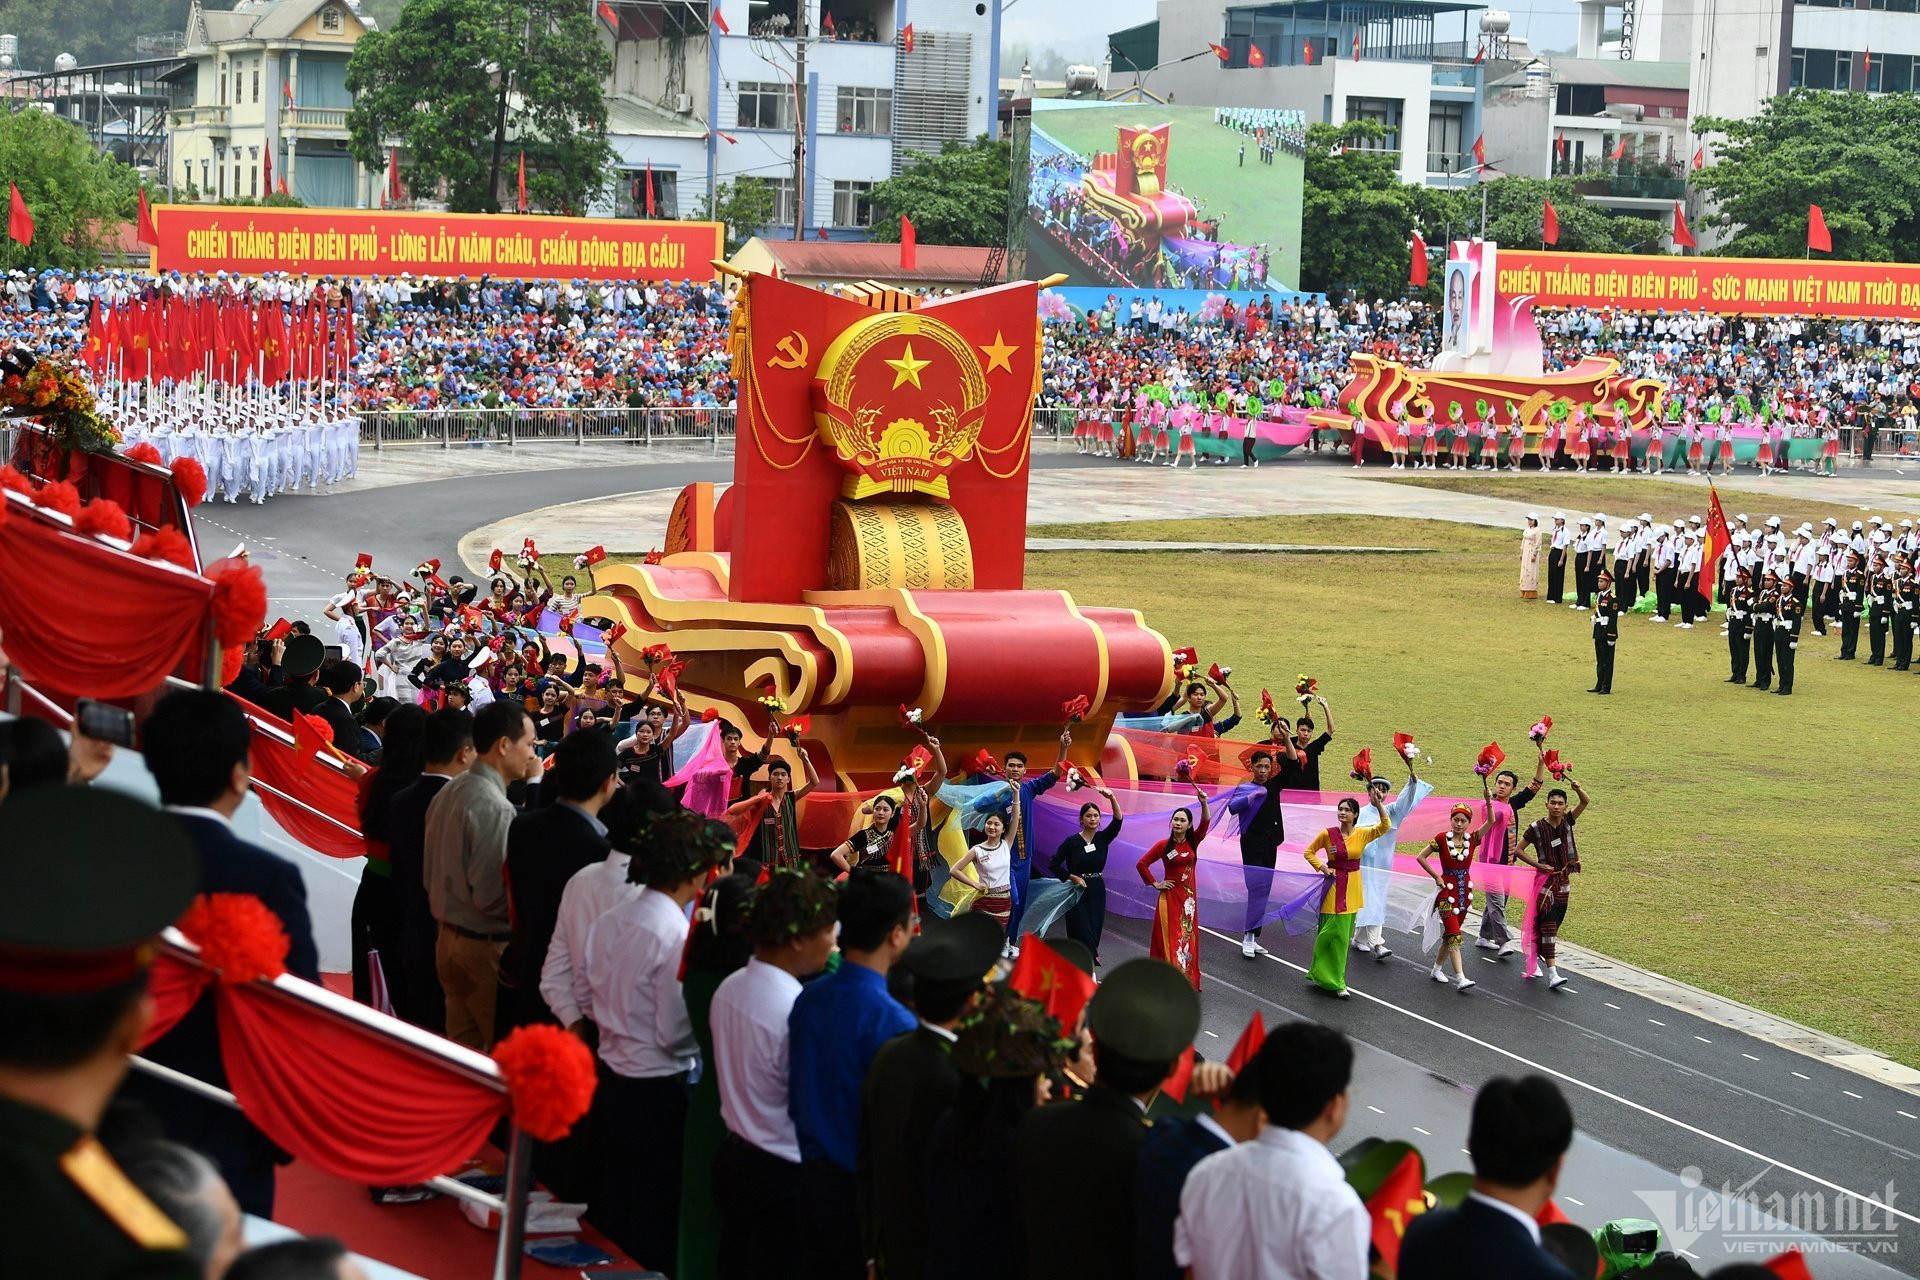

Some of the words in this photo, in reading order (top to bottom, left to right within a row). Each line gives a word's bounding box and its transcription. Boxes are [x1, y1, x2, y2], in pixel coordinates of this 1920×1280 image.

[187, 221, 227, 259] CHIẾN
[230, 220, 275, 260] THẮNG
[278, 226, 311, 266] ĐIỆN
[313, 227, 347, 261] BIÊN
[350, 225, 378, 262] PHỦ
[391, 229, 427, 263] LỪNG
[430, 225, 456, 263] LẪY
[459, 231, 492, 264] NĂM
[495, 232, 537, 268] CHÂU,
[540, 230, 578, 266] CHẤN
[581, 235, 619, 272] ĐỘNG
[622, 241, 647, 273] ĐỊA
[1499, 263, 1541, 294] CHIẾN
[1544, 263, 1591, 297] THẮNG
[1594, 269, 1628, 302] ĐIỆN
[1631, 270, 1666, 299] BIÊN
[1669, 269, 1698, 300] PHỦ
[1711, 273, 1741, 301] SỨC
[1744, 278, 1789, 307] MẠNH
[1792, 275, 1823, 308] VIỆT
[1826, 280, 1860, 305] NAM
[1865, 277, 1897, 306] THỜI
[880, 465, 904, 478] VIỆT
[906, 466, 930, 478] NAM
